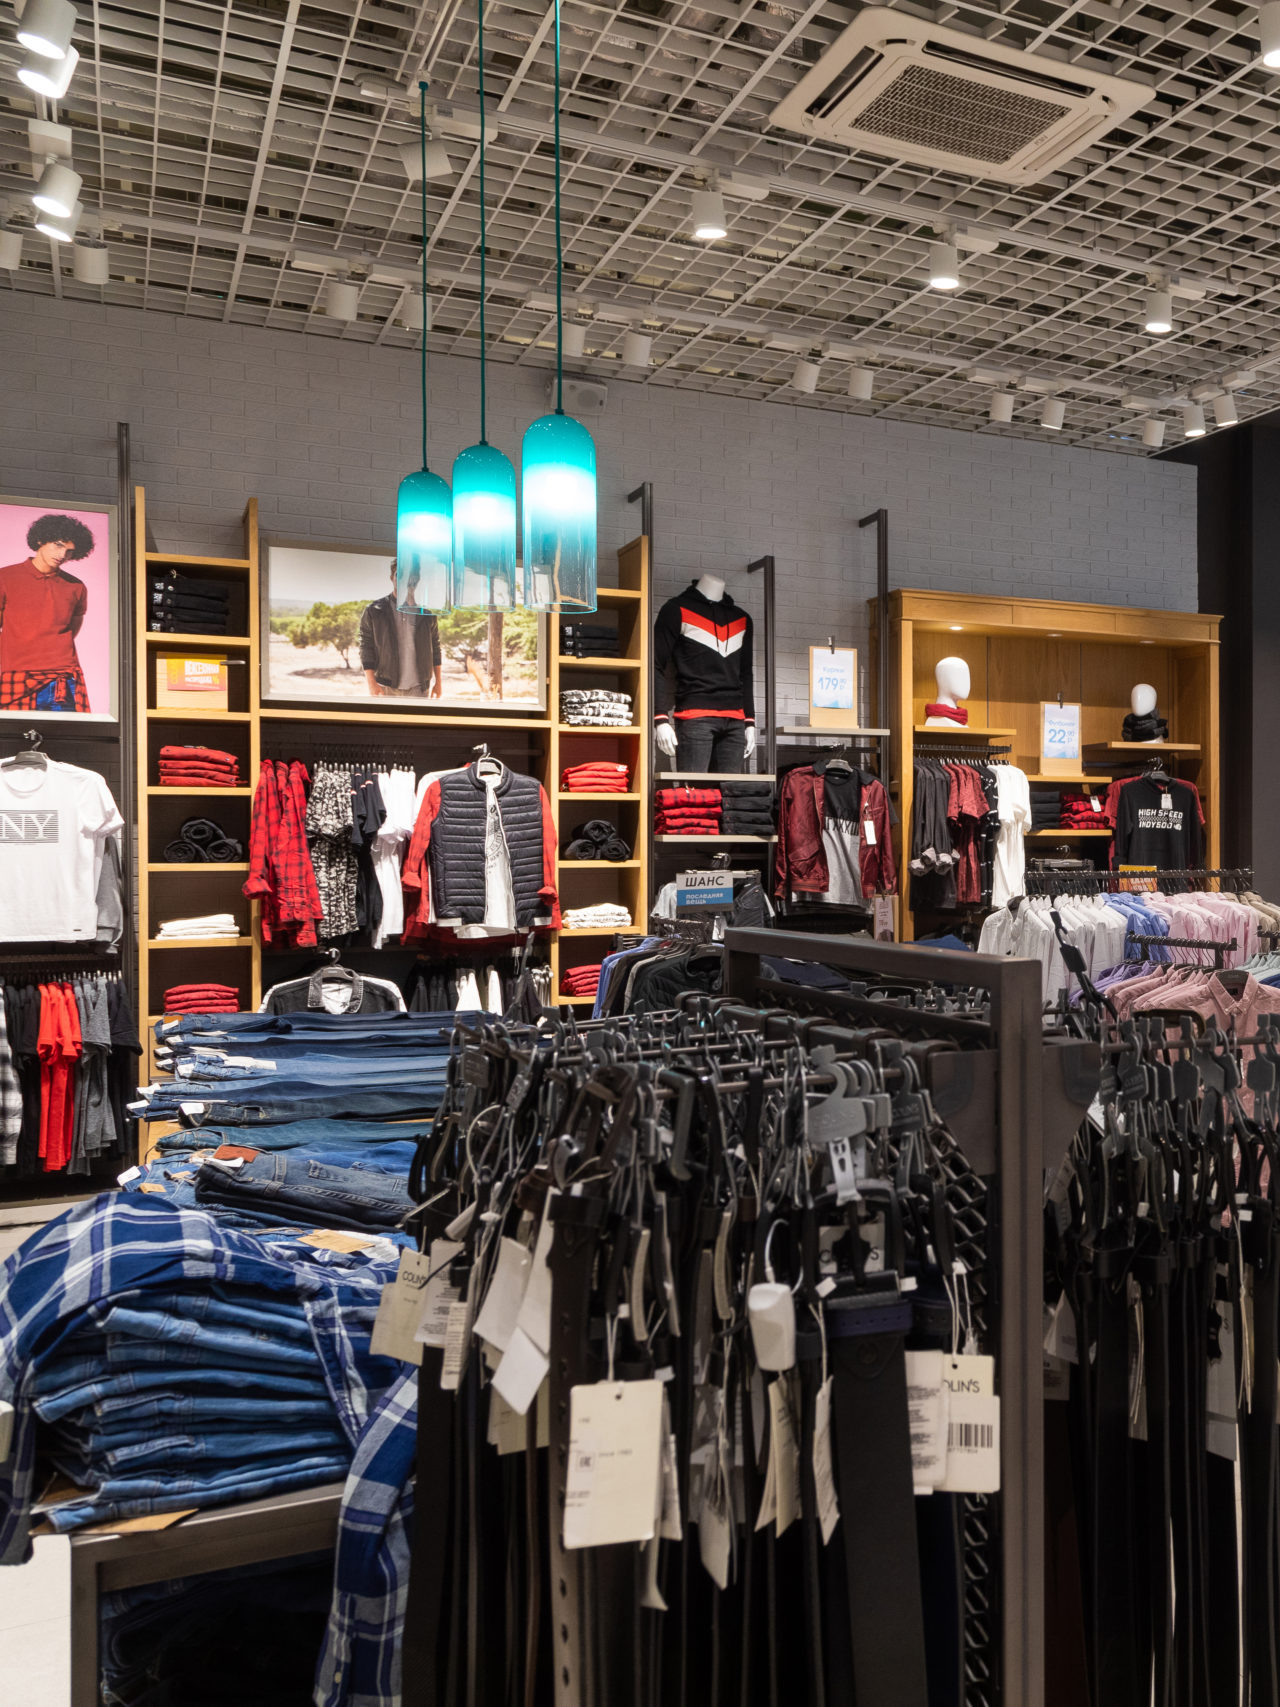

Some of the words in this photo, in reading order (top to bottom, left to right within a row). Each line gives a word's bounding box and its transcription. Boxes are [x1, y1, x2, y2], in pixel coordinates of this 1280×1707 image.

[818, 676, 838, 691] 179
[1048, 728, 1067, 744] 22
[1138, 808, 1157, 817] HIGH
[1158, 809, 1183, 819] SPEED
[685, 875, 725, 888] ШАНС
